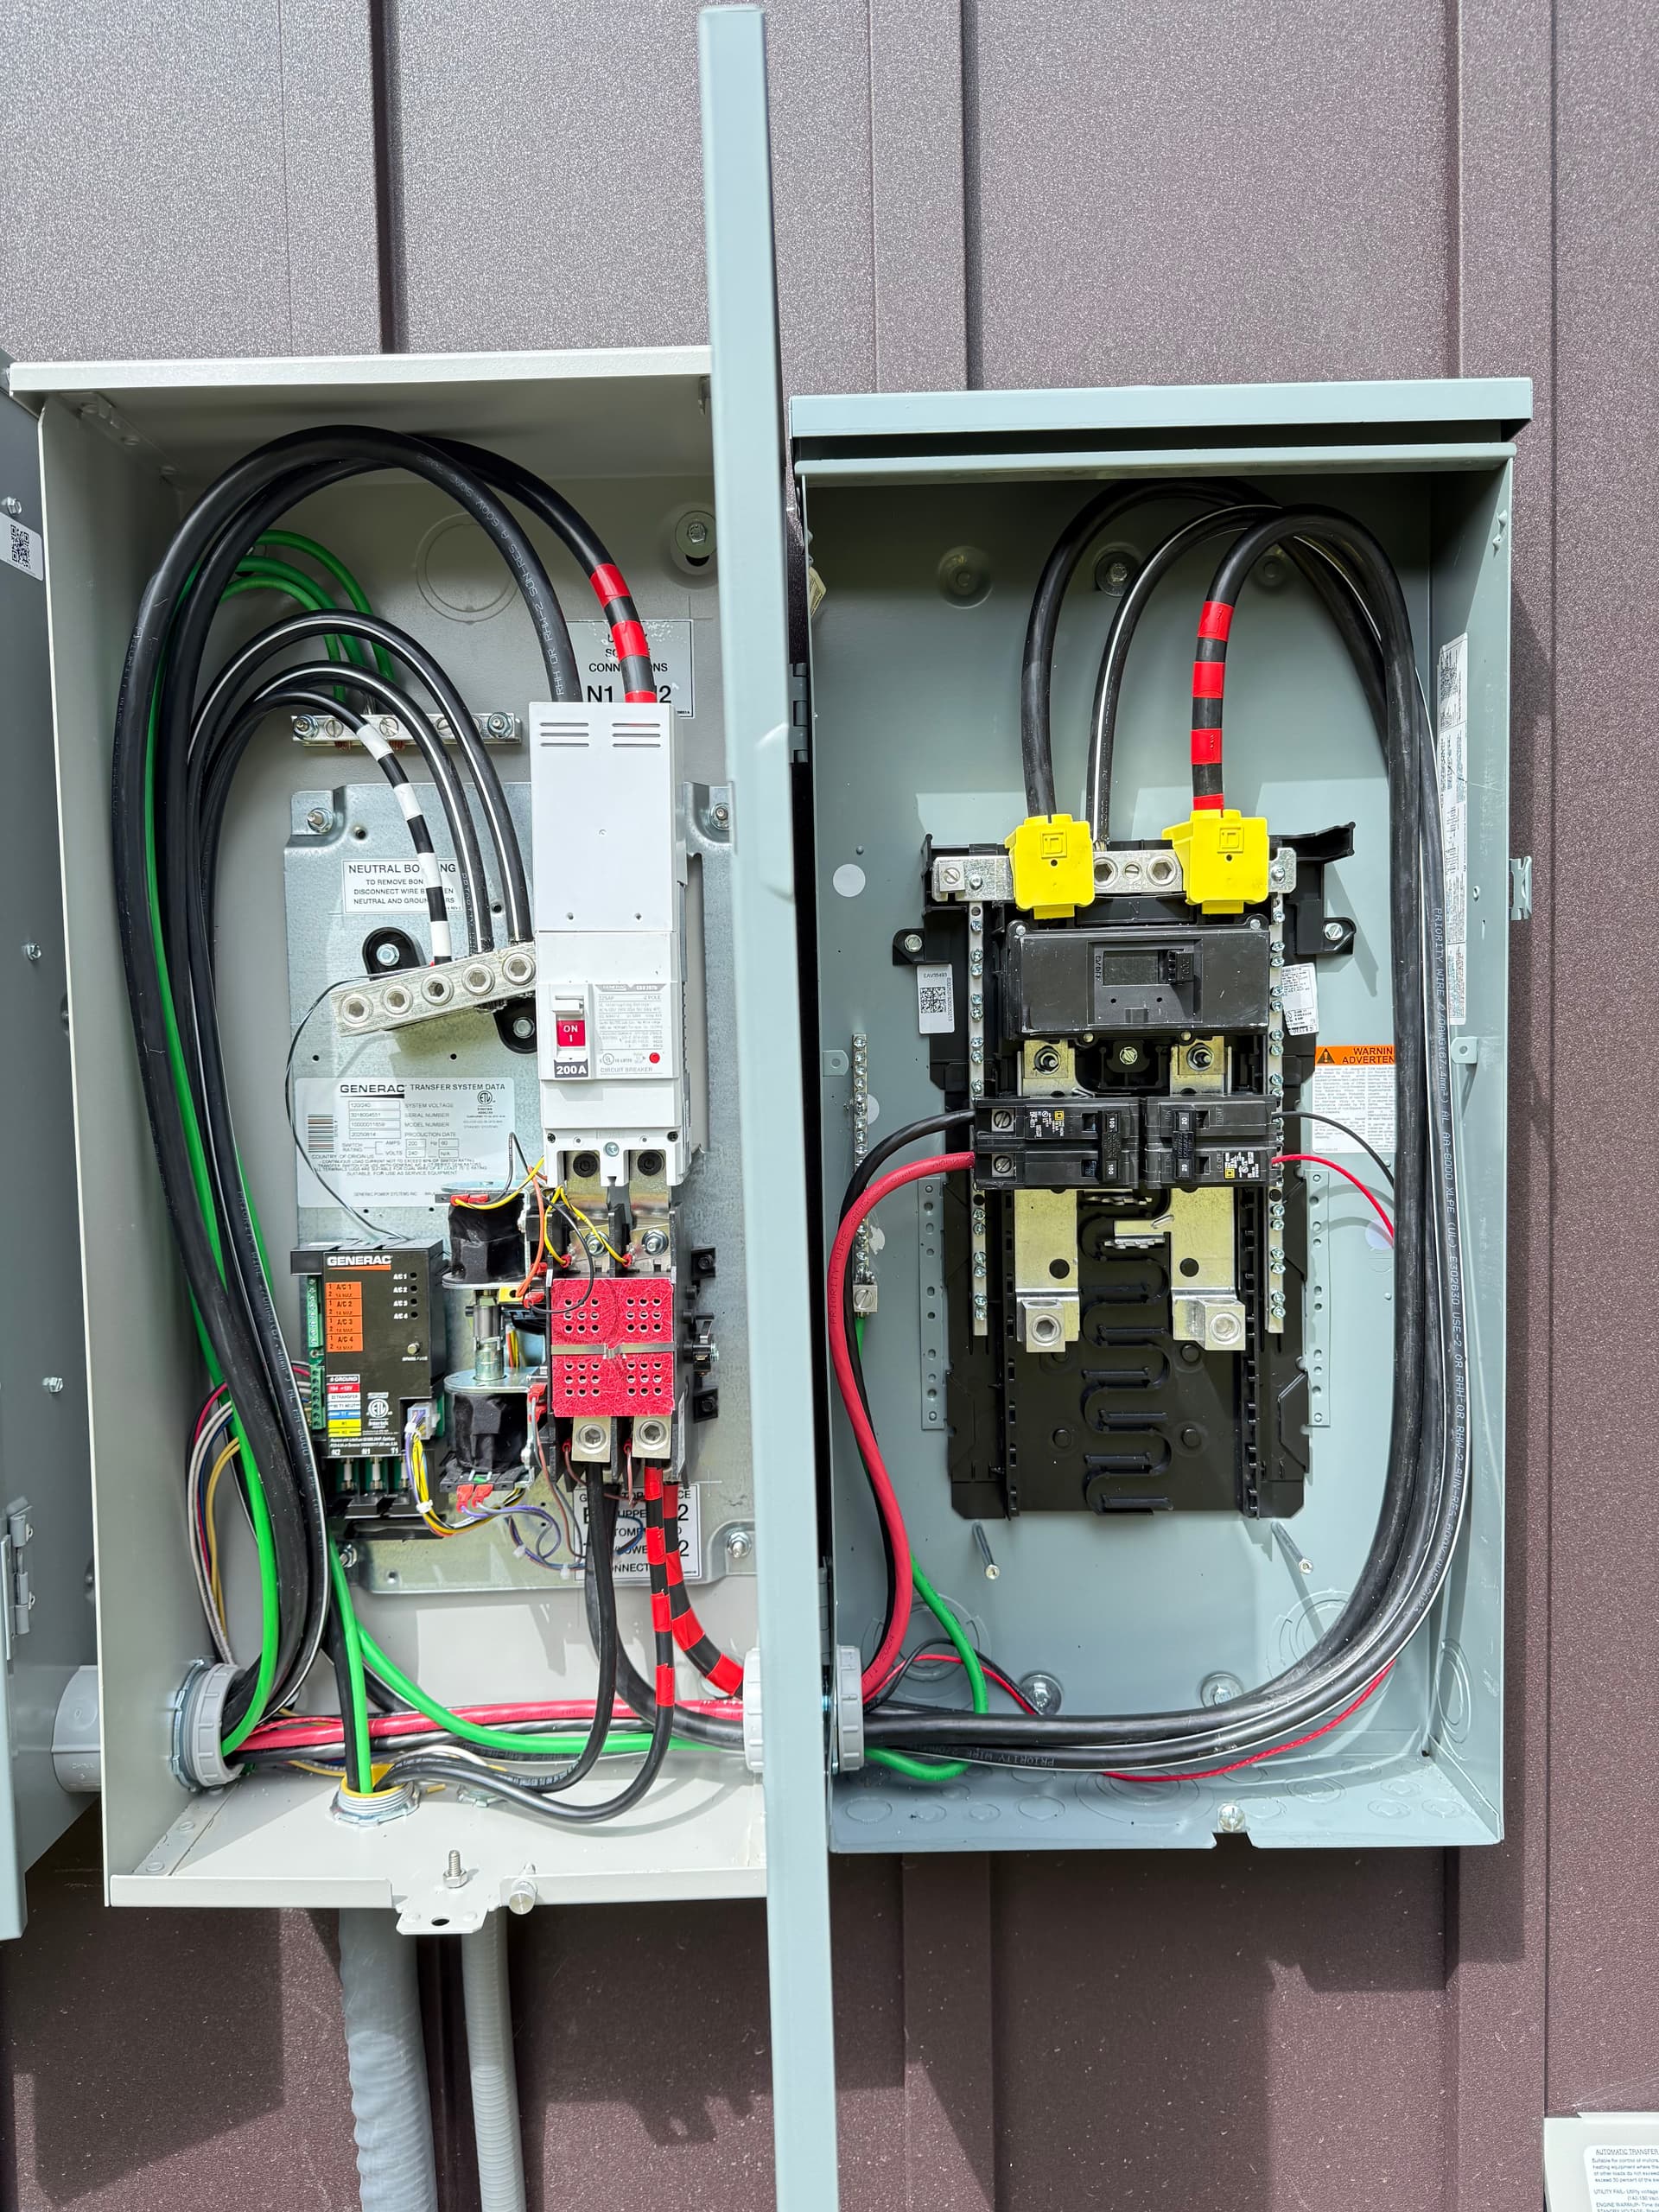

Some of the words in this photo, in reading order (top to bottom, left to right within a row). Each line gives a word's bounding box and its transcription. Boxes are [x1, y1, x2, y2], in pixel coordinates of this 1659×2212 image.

[507, 543, 539, 598] SUN-RES
[534, 602, 554, 642] RHW-2
[548, 648, 559, 664] OR
[588, 662, 668, 672] CONNNS
[556, 671, 565, 696] RHH
[587, 685, 613, 702] N1
[348, 864, 401, 874] NEUTRAL
[404, 864, 456, 874] BONG
[1433, 907, 1445, 963] PRIORITY
[1435, 968, 1446, 996] WIRE
[556, 1065, 587, 1075] 200A
[340, 1084, 405, 1093] GENERAC
[1440, 1110, 1449, 1124] AL
[1442, 1131, 1454, 1180] AA-8000
[1446, 1186, 1456, 1214] XLPE
[1446, 1221, 1457, 1249] (UL)
[327, 1255, 391, 1266] GENERAC
[1452, 1312, 1462, 1347] USE-2
[1453, 1354, 1463, 1368] OR
[1455, 1375, 1465, 1398] RHH
[1456, 1404, 1465, 1419] OR
[1455, 1426, 1465, 1461] RHW-2
[967, 1749, 993, 1760] WIRE
[999, 1754, 1056, 1767] PRIORITY
